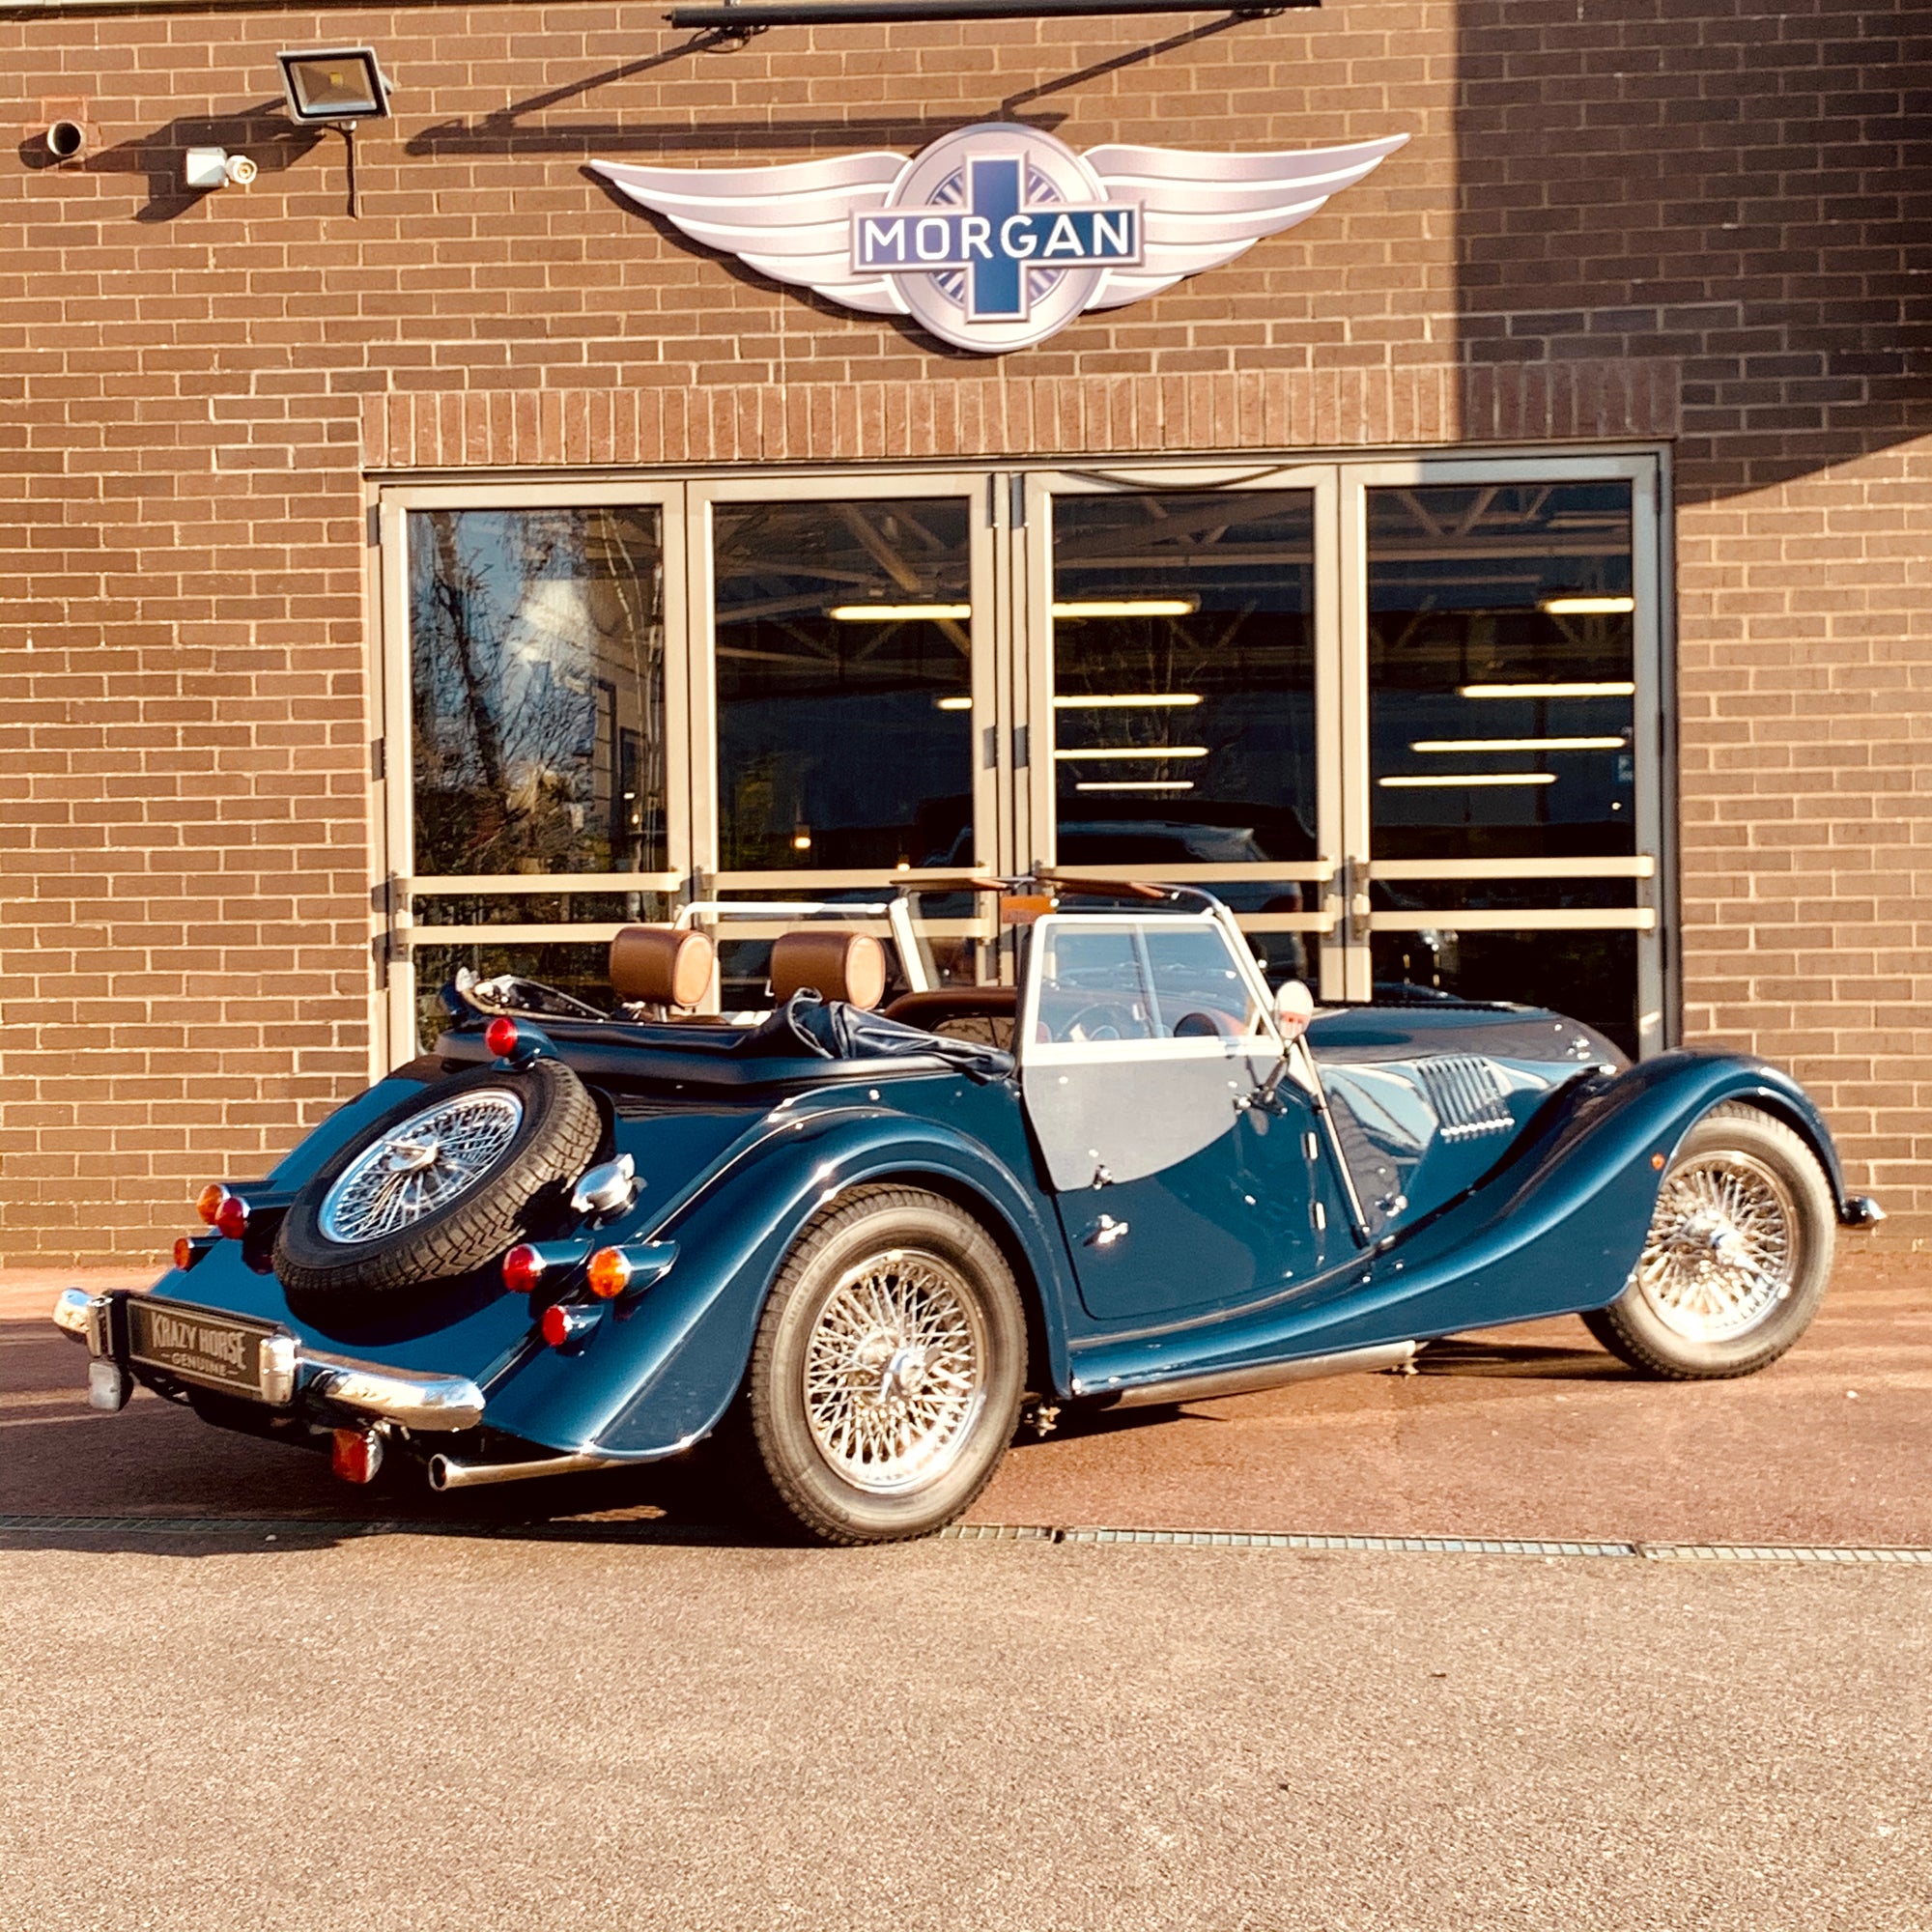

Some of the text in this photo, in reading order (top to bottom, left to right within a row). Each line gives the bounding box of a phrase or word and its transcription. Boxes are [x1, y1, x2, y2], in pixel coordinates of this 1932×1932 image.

[866, 213, 1128, 262] MORGAN
[151, 1312, 246, 1370] KRAZY HORSE
[172, 1352, 227, 1376] GENUINE
